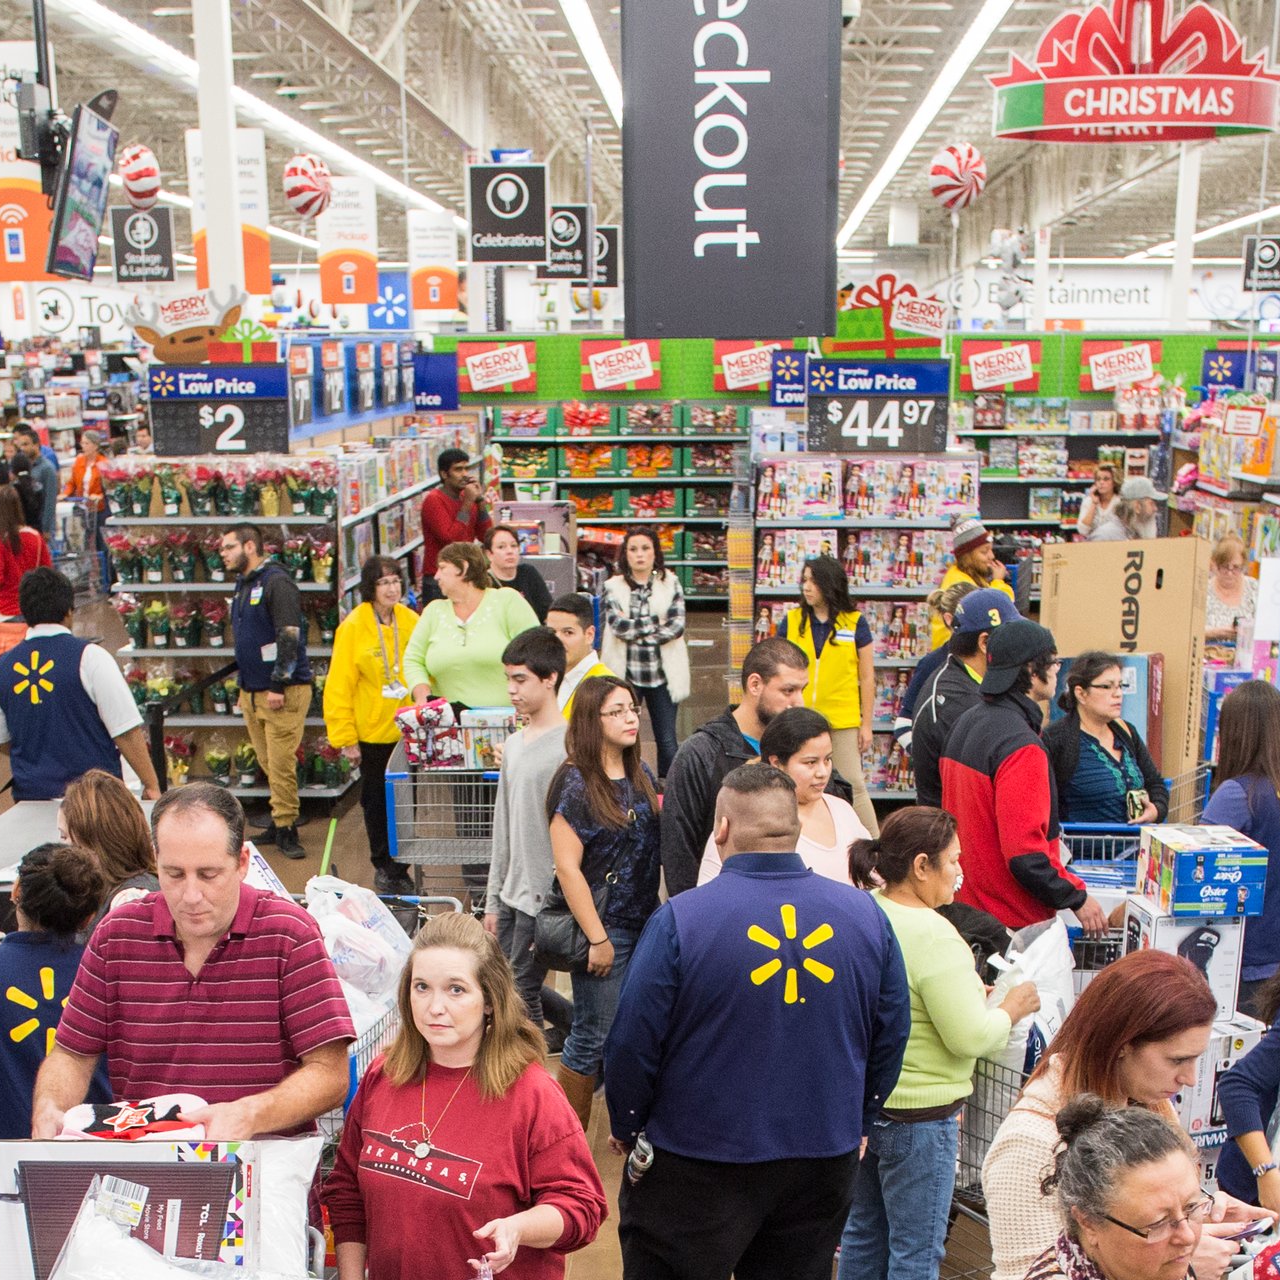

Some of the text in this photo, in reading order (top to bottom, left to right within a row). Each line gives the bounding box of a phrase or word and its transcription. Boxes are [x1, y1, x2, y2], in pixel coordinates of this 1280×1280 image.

[1063, 86, 1234, 119] CHRISTMAS
[473, 233, 546, 248] Celebrations
[161, 295, 206, 316] MERRY
[895, 299, 947, 318] MERRY
[163, 308, 210, 325] CHRISTMAS
[470, 349, 522, 373] MERRY
[593, 346, 645, 371] MERRY
[972, 350, 1025, 373] MERRY
[1094, 349, 1145, 372] MERRY
[474, 362, 524, 382] CHRISTMAS
[597, 361, 647, 381] CHRISTMAS
[976, 362, 1027, 381] CHRISTMAS
[1096, 362, 1148, 381] CHRISTMAS
[179, 379, 256, 395] Low Price
[838, 375, 917, 391] Low Price
[776, 390, 807, 404] Low
[199, 404, 247, 450] $2
[988, 608, 1001, 626] 3
[1200, 885, 1229, 898] Oster
[142, 1223, 151, 1240] Store
[195, 1203, 211, 1253] TCL Roku
